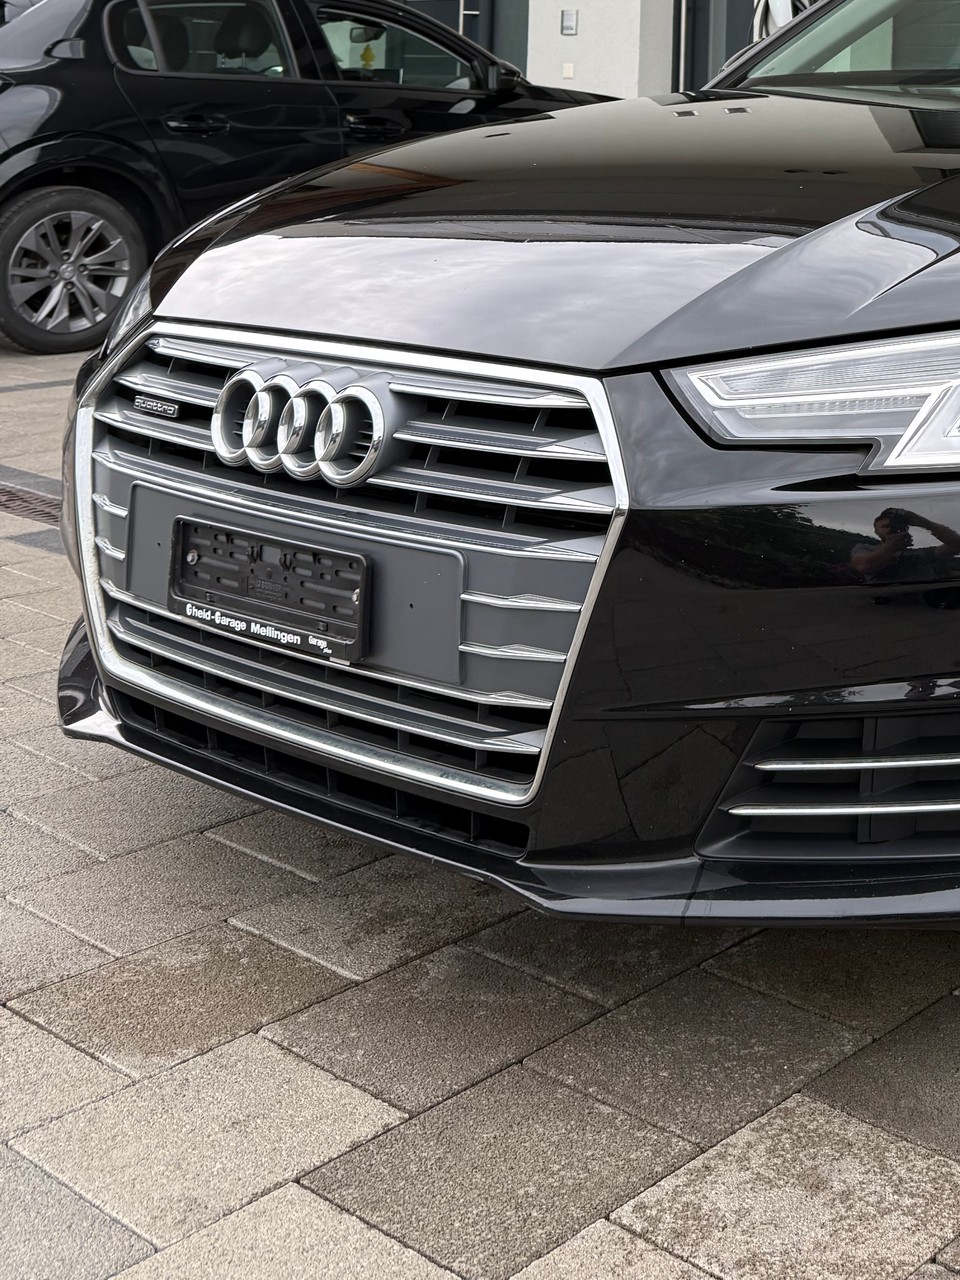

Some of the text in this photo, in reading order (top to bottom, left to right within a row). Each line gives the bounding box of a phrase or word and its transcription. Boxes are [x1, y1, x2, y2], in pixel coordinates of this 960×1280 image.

[135, 399, 175, 415] quattro
[250, 622, 302, 645] Mellingen
[308, 635, 328, 649] Garage
